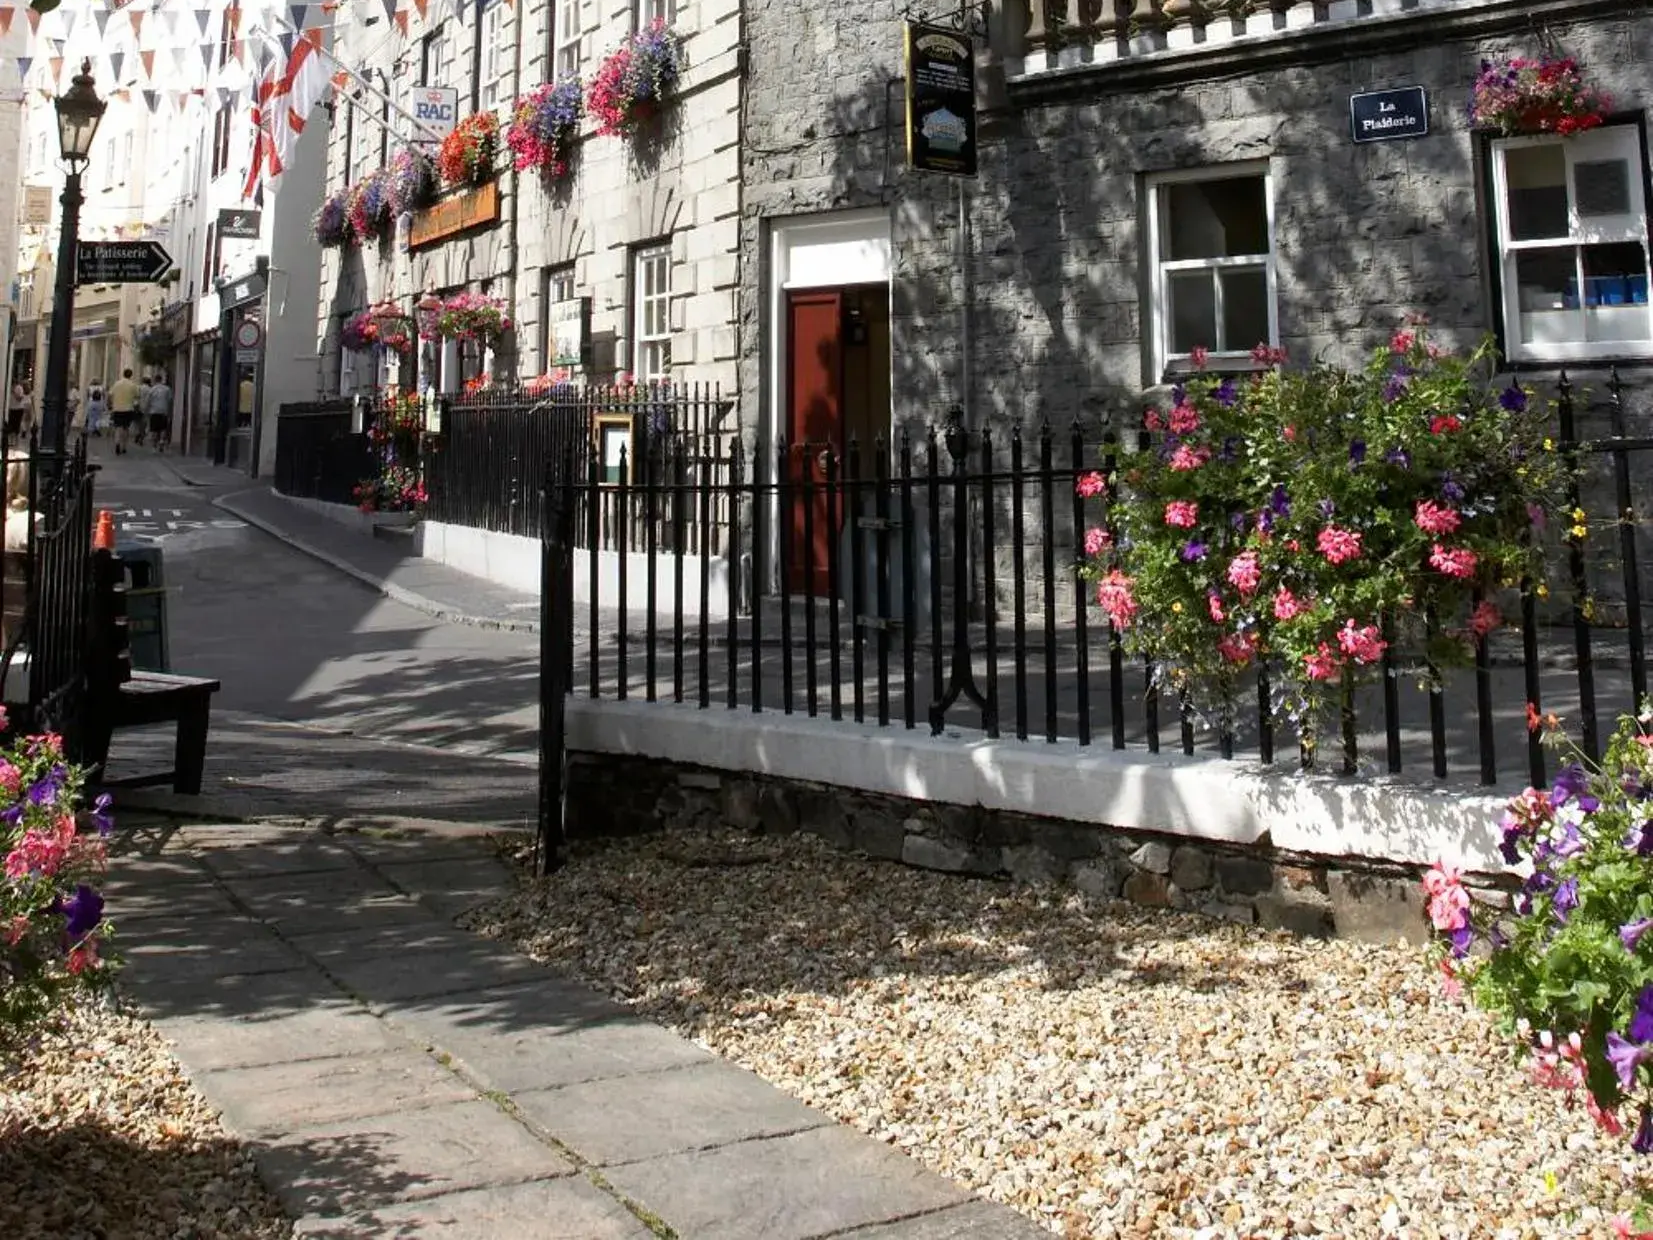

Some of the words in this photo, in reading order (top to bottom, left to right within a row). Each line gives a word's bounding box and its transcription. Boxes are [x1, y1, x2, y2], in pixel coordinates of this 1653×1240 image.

[416, 102, 452, 120] RAC
[1379, 101, 1396, 112] La
[1361, 115, 1416, 131] Plaiderie
[80, 247, 91, 259] La
[95, 245, 148, 259] Patisserie
